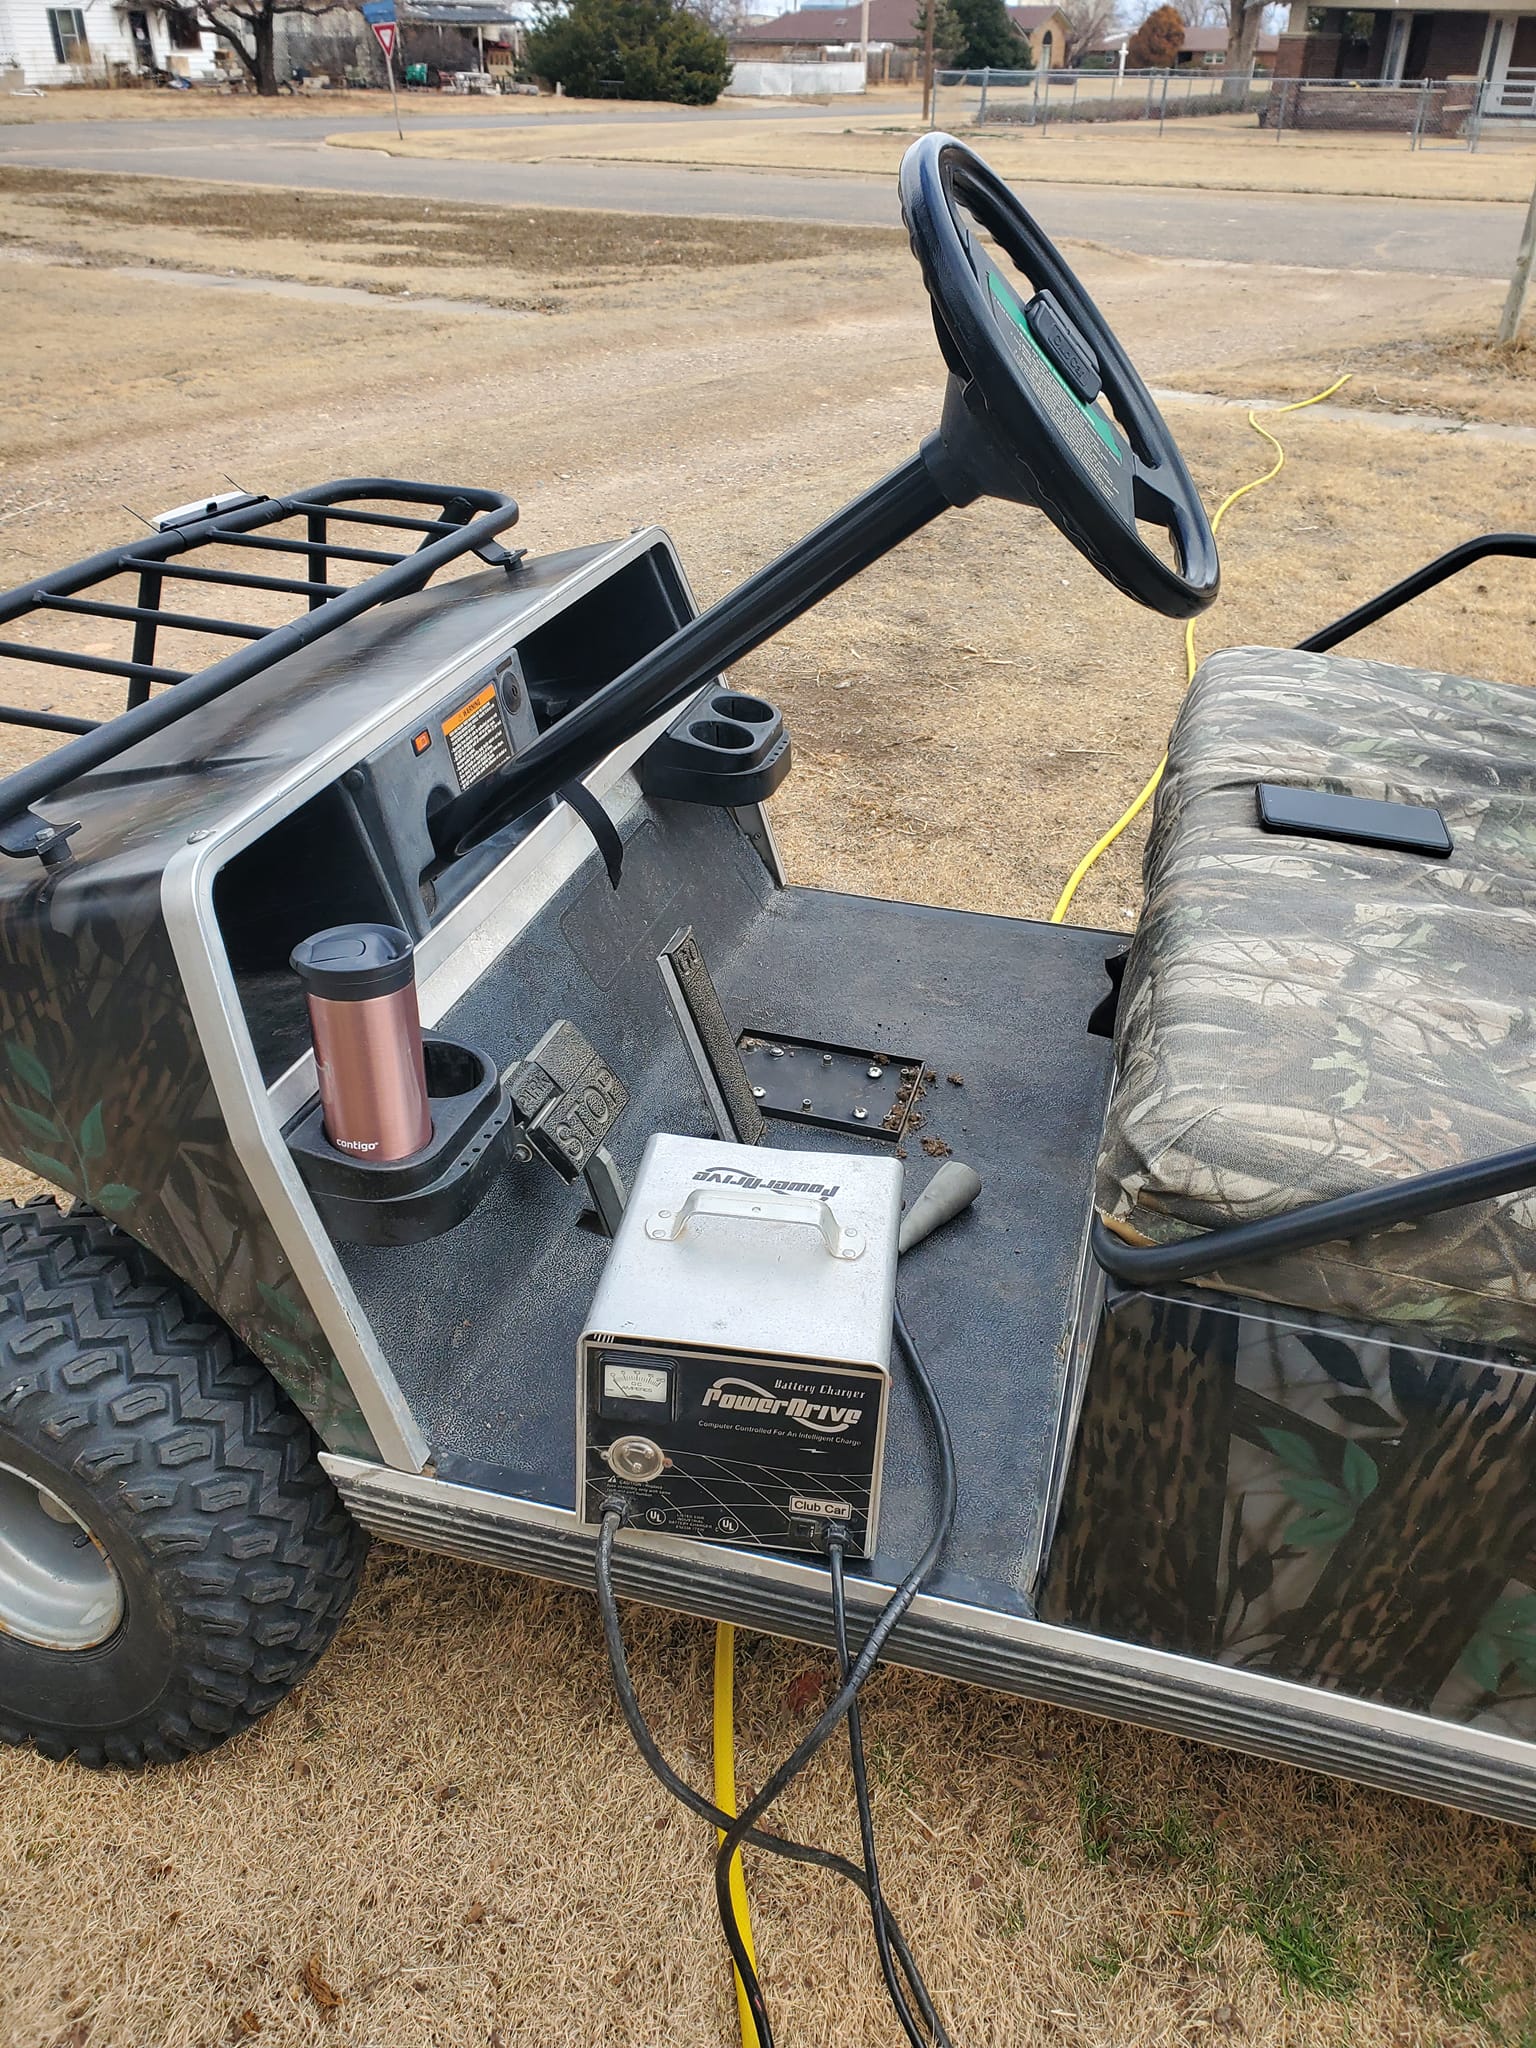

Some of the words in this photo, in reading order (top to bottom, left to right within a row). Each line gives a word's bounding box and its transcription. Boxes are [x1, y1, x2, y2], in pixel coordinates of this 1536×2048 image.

[556, 1066, 618, 1161] STOP
[336, 1138, 377, 1152] contigo
[691, 1168, 841, 1199] PowerDrive
[774, 1378, 816, 1394] Battery
[818, 1384, 866, 1399] Charger
[701, 1387, 863, 1425] PowerDrive
[698, 1420, 733, 1430] Computer
[734, 1424, 772, 1435] Controlled
[773, 1428, 786, 1436] For
[786, 1430, 798, 1438] An
[798, 1431, 834, 1442] Intelligent
[835, 1436, 862, 1447] Charge
[794, 1500, 821, 1512] Club
[824, 1504, 847, 1515] Car
